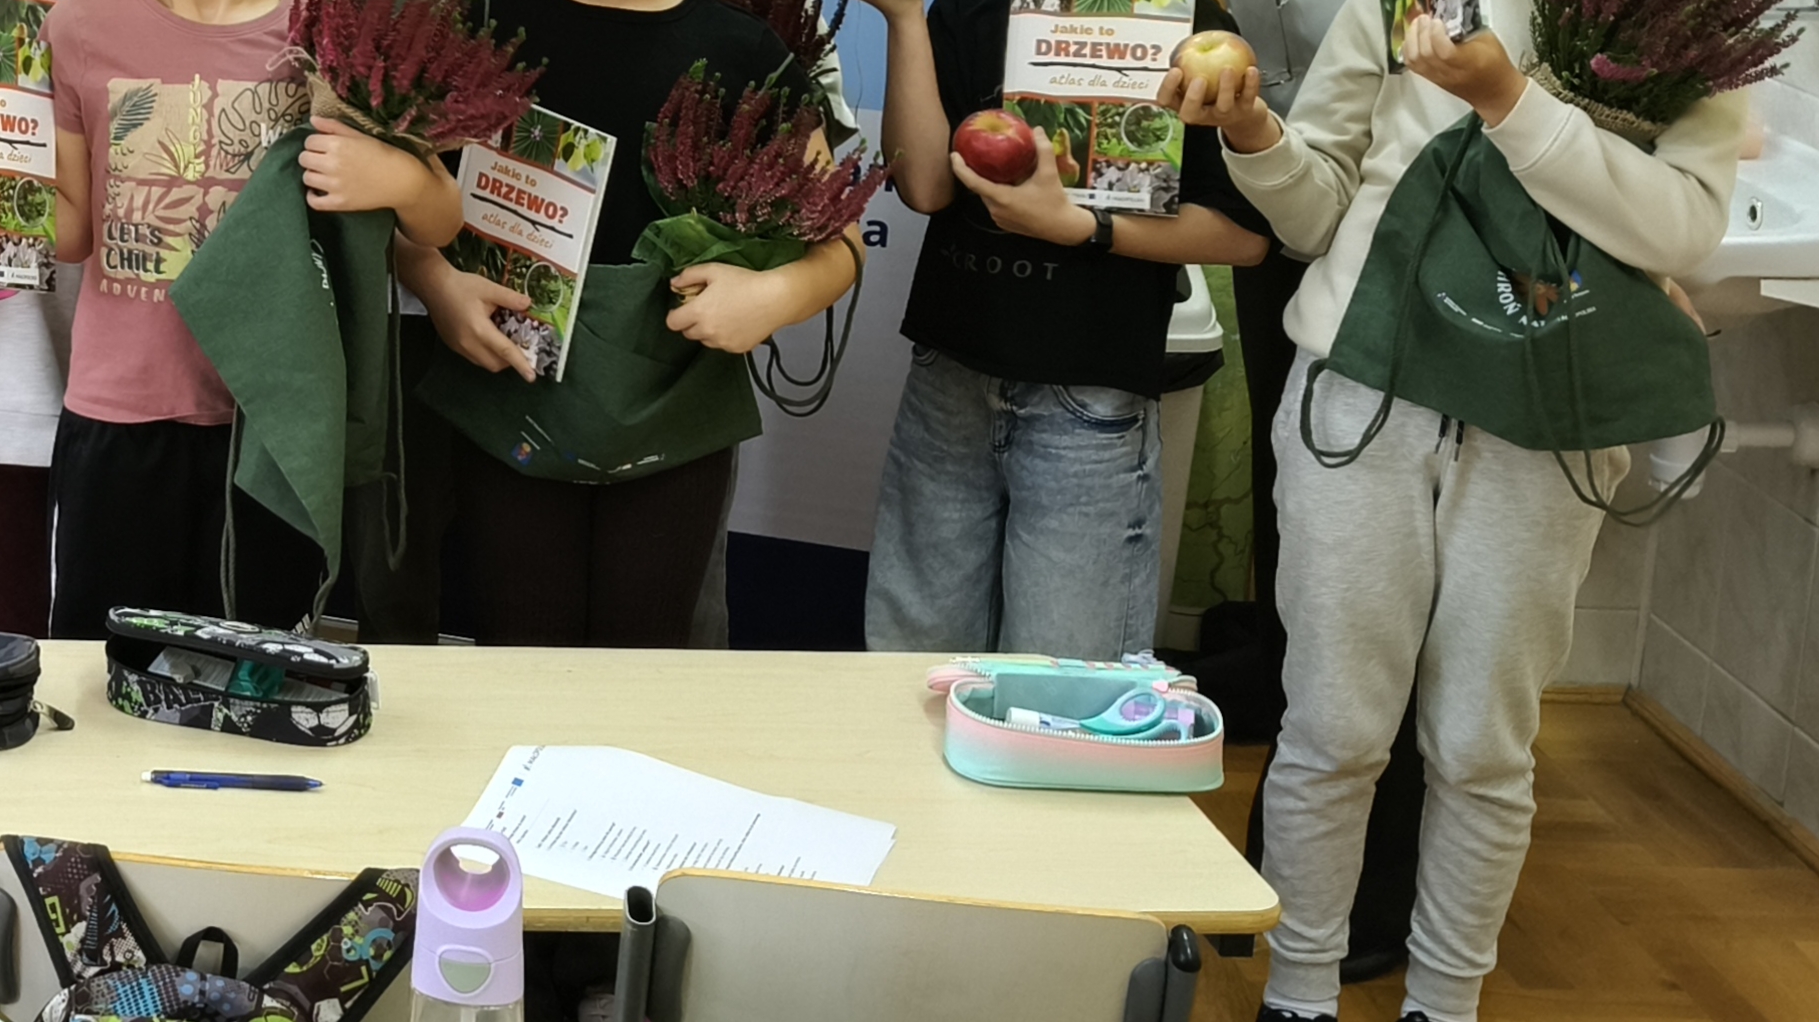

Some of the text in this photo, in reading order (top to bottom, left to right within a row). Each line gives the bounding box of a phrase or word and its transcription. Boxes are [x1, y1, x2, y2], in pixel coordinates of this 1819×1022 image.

[1050, 24, 1115, 36] Jakie to
[1035, 38, 1163, 62] DRZEWO?
[1049, 73, 1150, 90] atlas dla dzieci
[7, 150, 32, 164] dzieci
[490, 161, 537, 187] Jakie to
[476, 171, 569, 224] DRZEWO?
[106, 219, 164, 246] LET'S
[481, 212, 554, 250] atlas dla dzieci
[100, 278, 166, 303] ADVEN
